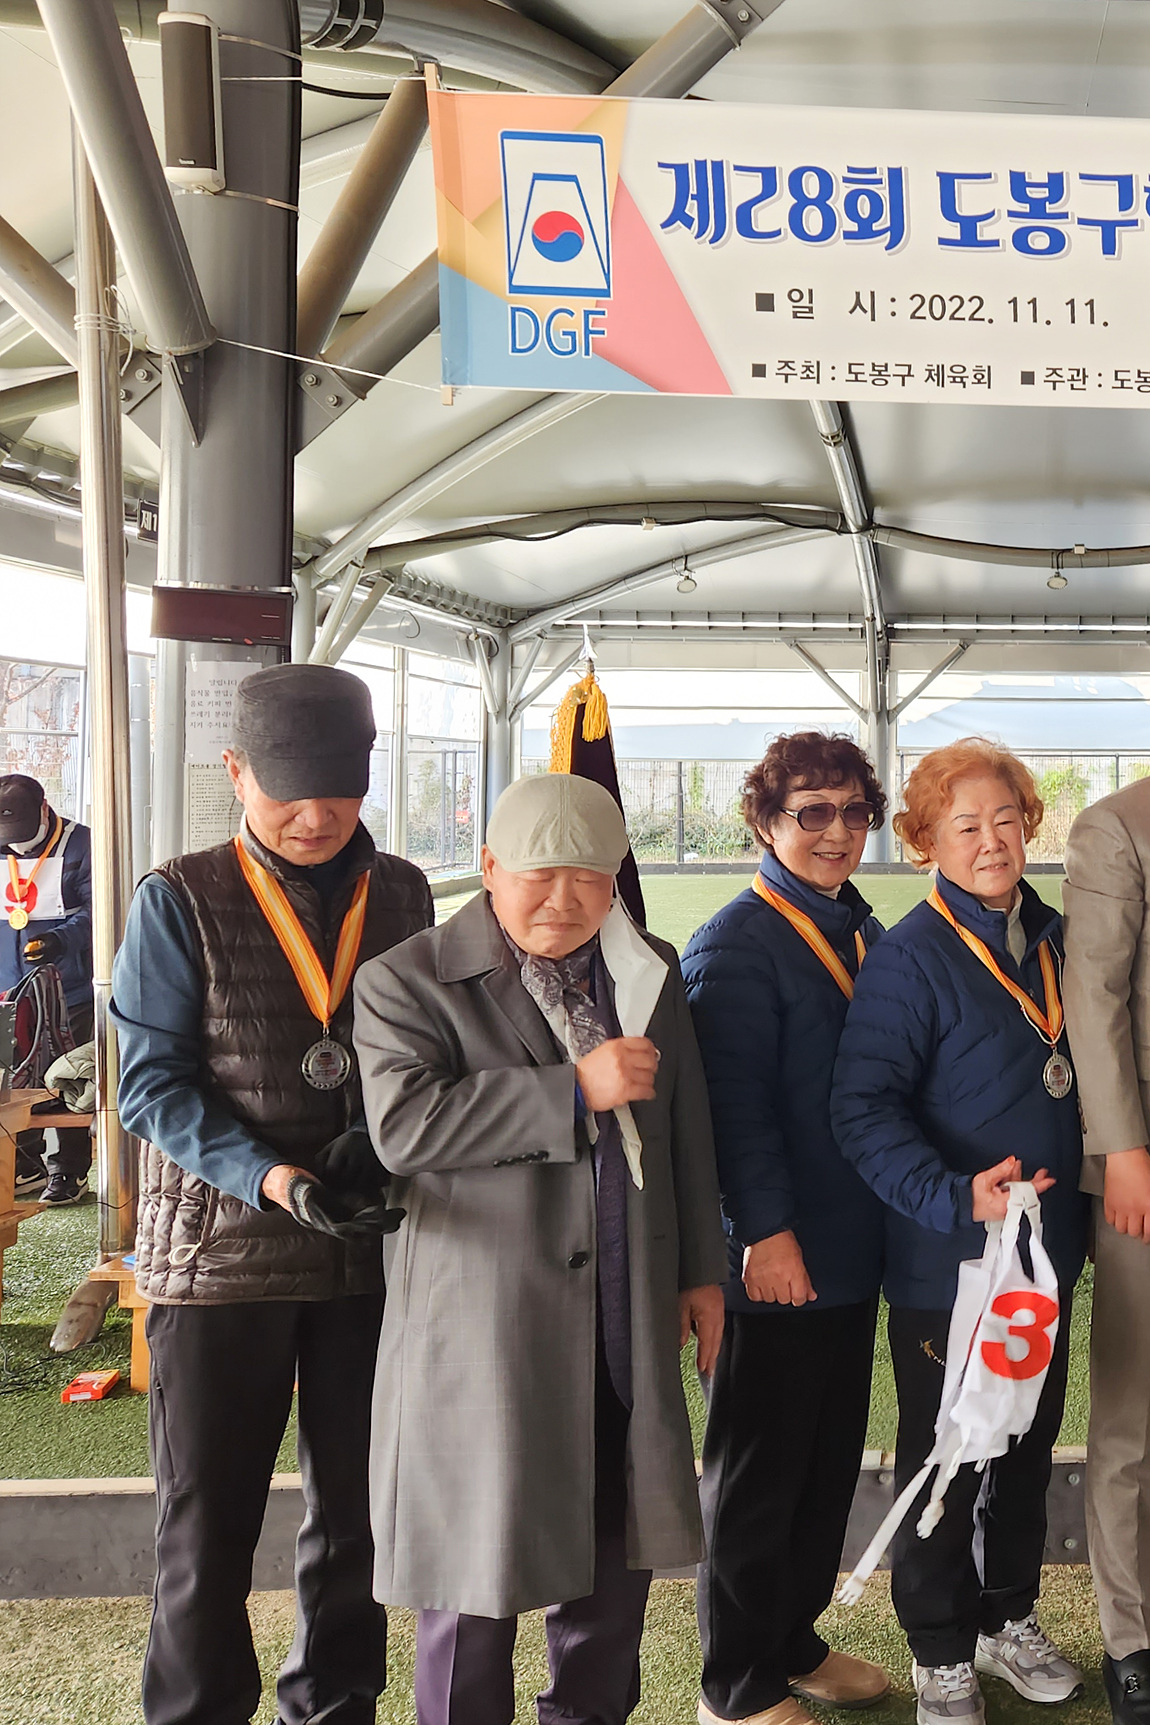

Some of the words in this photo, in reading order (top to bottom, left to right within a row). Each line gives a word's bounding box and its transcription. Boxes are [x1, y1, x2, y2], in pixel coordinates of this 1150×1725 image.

[657, 159, 906, 252] 제28회
[509, 305, 607, 357] DGF
[909, 293, 994, 325] 2022.
[1007, 296, 1052, 326] 11.
[1065, 298, 1109, 328] 11.
[844, 362, 915, 387] 도봉구
[924, 363, 992, 390] 체육회
[5, 878, 38, 915] 9
[980, 1290, 1060, 1381] 3
